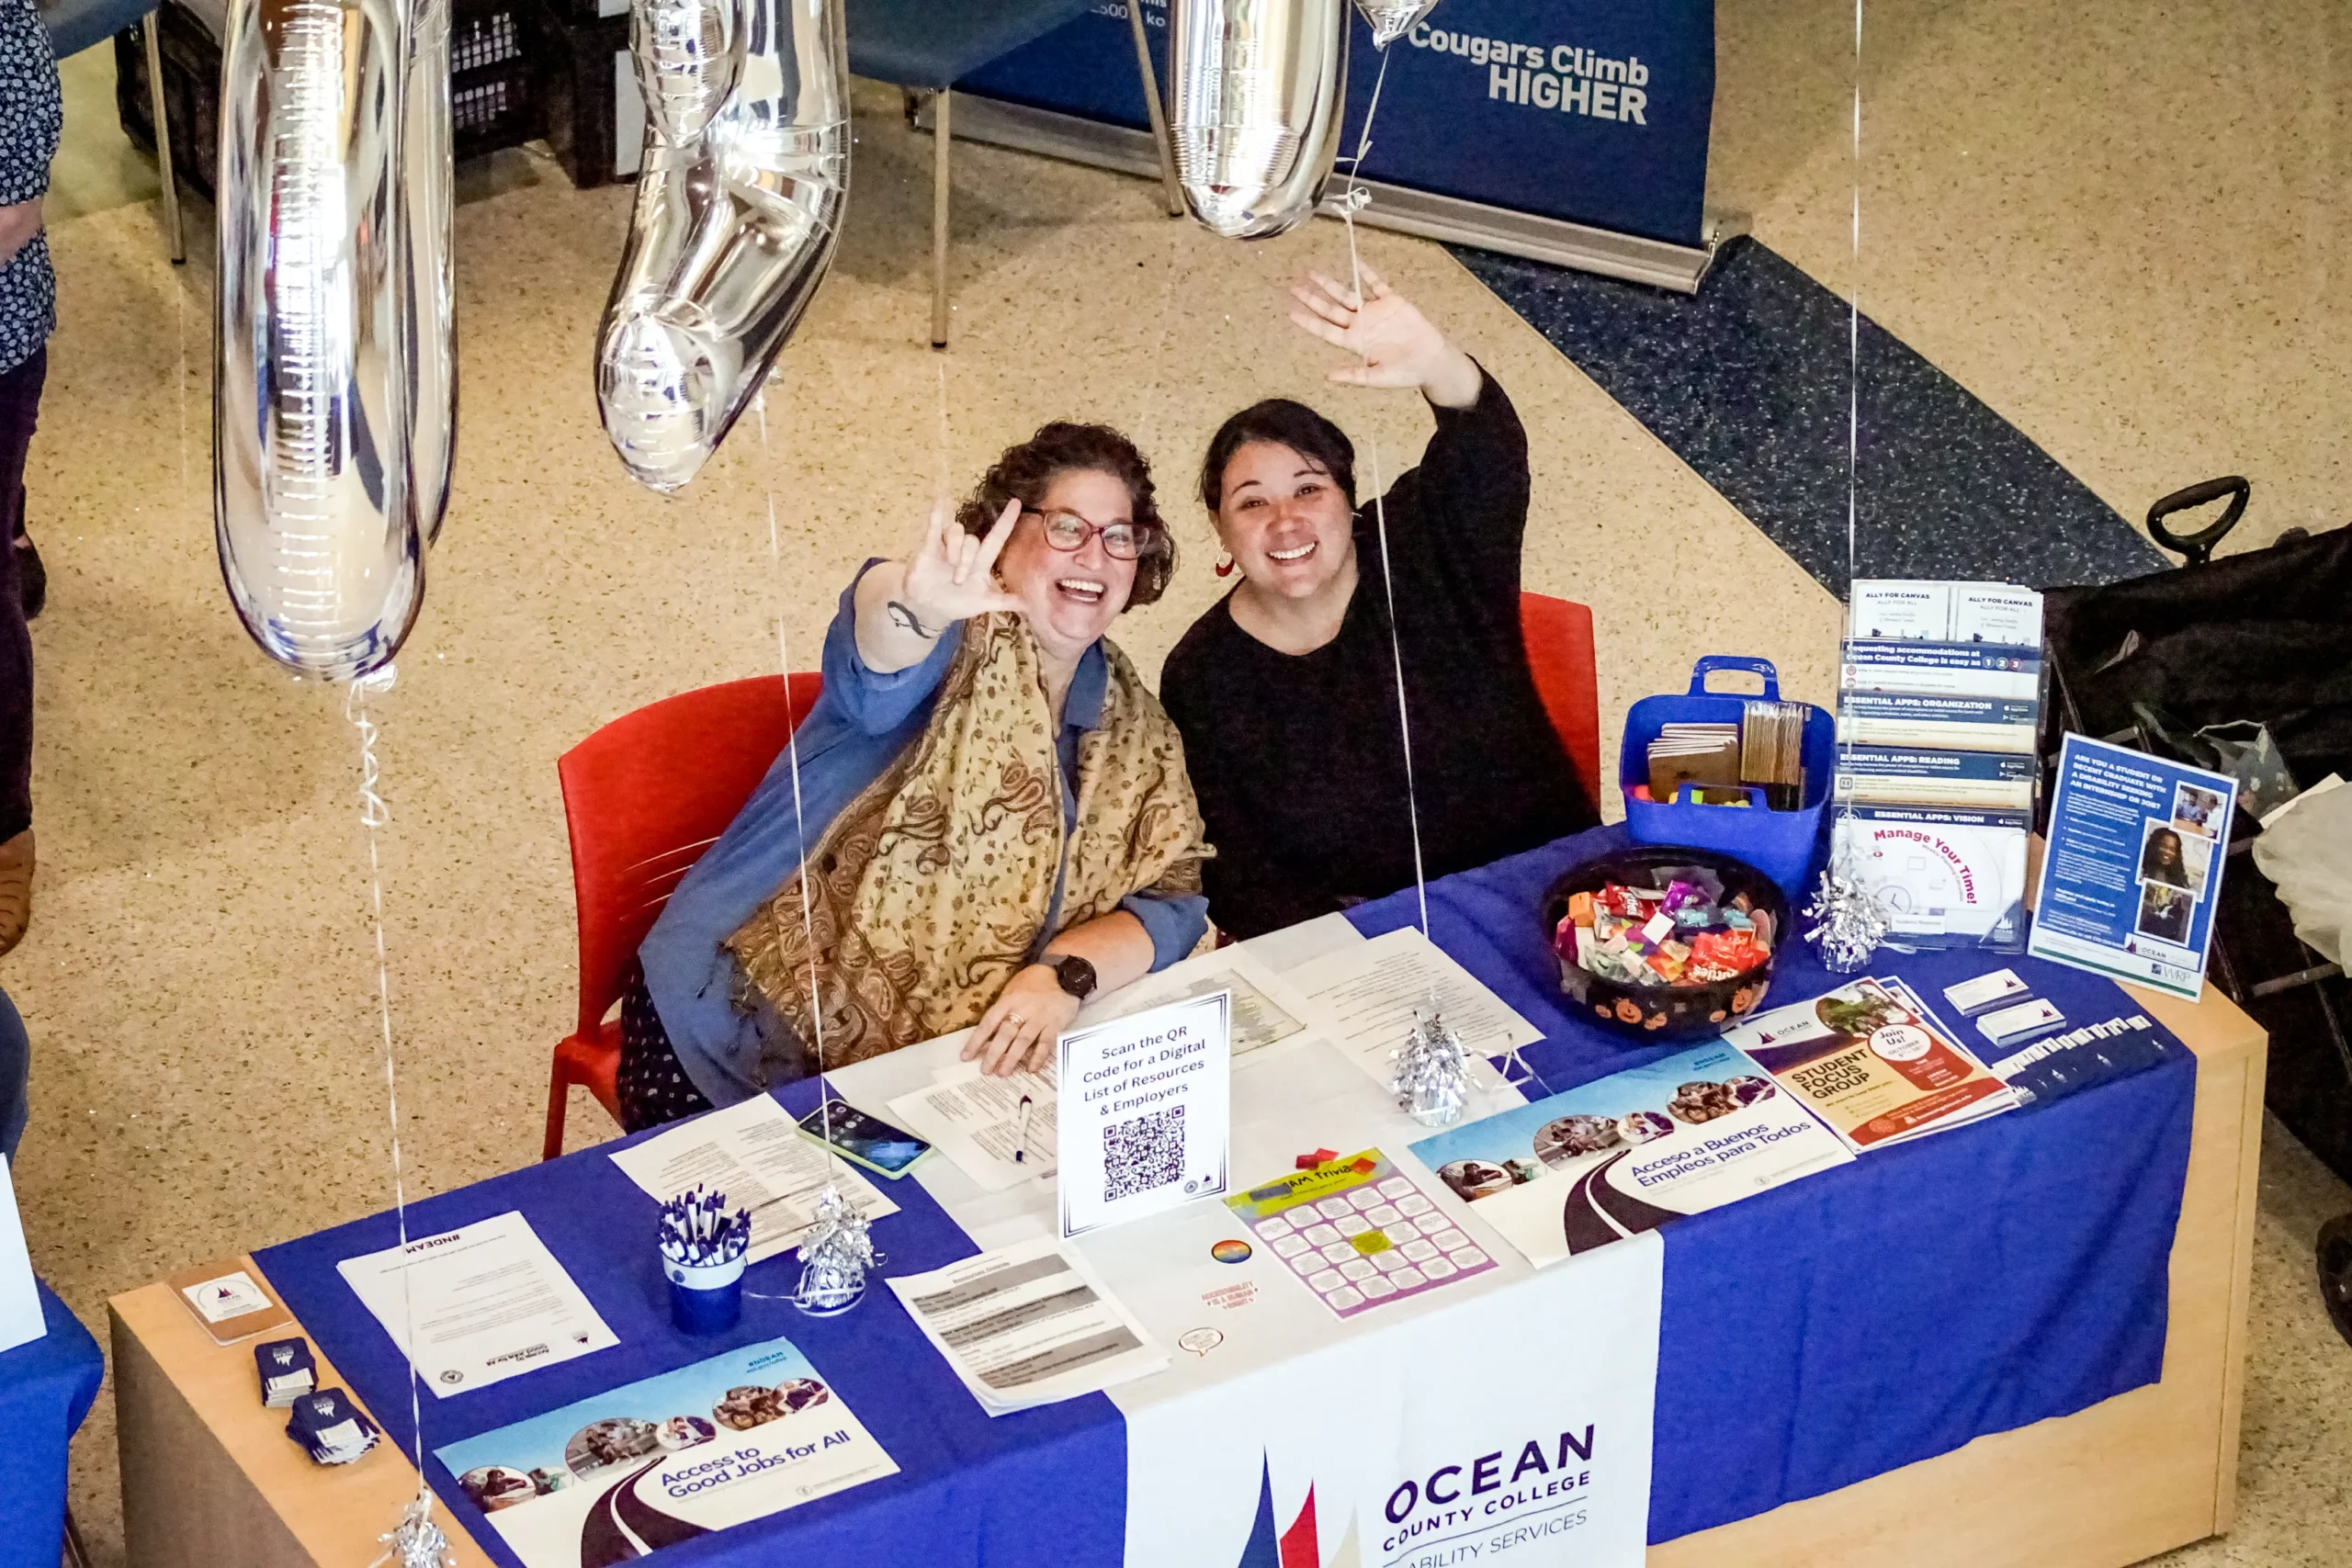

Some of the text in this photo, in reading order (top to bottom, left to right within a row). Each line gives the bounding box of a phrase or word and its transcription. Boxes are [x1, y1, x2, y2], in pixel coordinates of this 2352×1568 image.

[1408, 21, 1649, 86] Cougars Climb
[1488, 63, 1647, 125] HIGHER
[2003, 599, 2033, 607] CANVAS
[1874, 654, 1905, 663] County
[1907, 655, 1939, 665] College
[1950, 659, 1969, 667] easy
[1896, 647, 1969, 657] accommodations
[1970, 649, 1981, 658] at
[1843, 696, 1992, 710] ESSENTIAL APPS: ORGANIZATION
[1839, 753, 1961, 765] ESSENTIAL APPS: READING
[2074, 754, 2090, 763] ARE
[2092, 757, 2108, 768] YOU
[2116, 764, 2151, 780] STUDENT
[2151, 774, 2164, 784] OR
[2073, 762, 2166, 794] RECENT GRADUATE WITH
[2078, 773, 2120, 790] DISABILITY
[2121, 783, 2154, 798] SEEKING
[2070, 780, 2161, 810] AN INTERNSHIP OR JOB?
[1874, 810, 1984, 823] ESSENTIAL APPS: VISION
[1873, 829, 1977, 905] Manage Your Time!
[2142, 947, 2166, 959] OCEAN
[2163, 965, 2191, 983] WRP
[1102, 1025, 1188, 1059] Scan the QR
[1776, 1021, 1810, 1036] OCEAN
[1879, 1029, 1905, 1039] Join
[1885, 1035, 1906, 1045] Us!
[1083, 1038, 1205, 1083] Code for a Digital
[1792, 1048, 1869, 1083] STUDENT
[1084, 1059, 1204, 1102] List of Resources
[1801, 1066, 1862, 1091] FOCUS
[1812, 1071, 1871, 1100] GROUP
[1100, 1082, 1189, 1116] & Employers
[1631, 1151, 1691, 1178] Acceso
[1693, 1145, 1706, 1156] a
[1703, 1123, 1770, 1151] Buenos
[1636, 1156, 1715, 1187] Empleos
[1716, 1141, 1758, 1163] para
[1757, 1121, 1811, 1145] Todos
[1314, 1165, 1352, 1179] Trivia
[405, 1234, 460, 1255] #NDEAM
[748, 1351, 784, 1367] #NDEAM
[662, 1453, 735, 1487] Access
[735, 1447, 761, 1460] to
[668, 1470, 731, 1497] Good
[736, 1453, 786, 1477] Jobs
[786, 1442, 819, 1461] for
[822, 1429, 851, 1450] All
[1385, 1423, 1595, 1524] OCEAN
[1383, 1470, 1590, 1552] COUNTY COLLEGE
[1489, 1509, 1588, 1554] SERVICES
